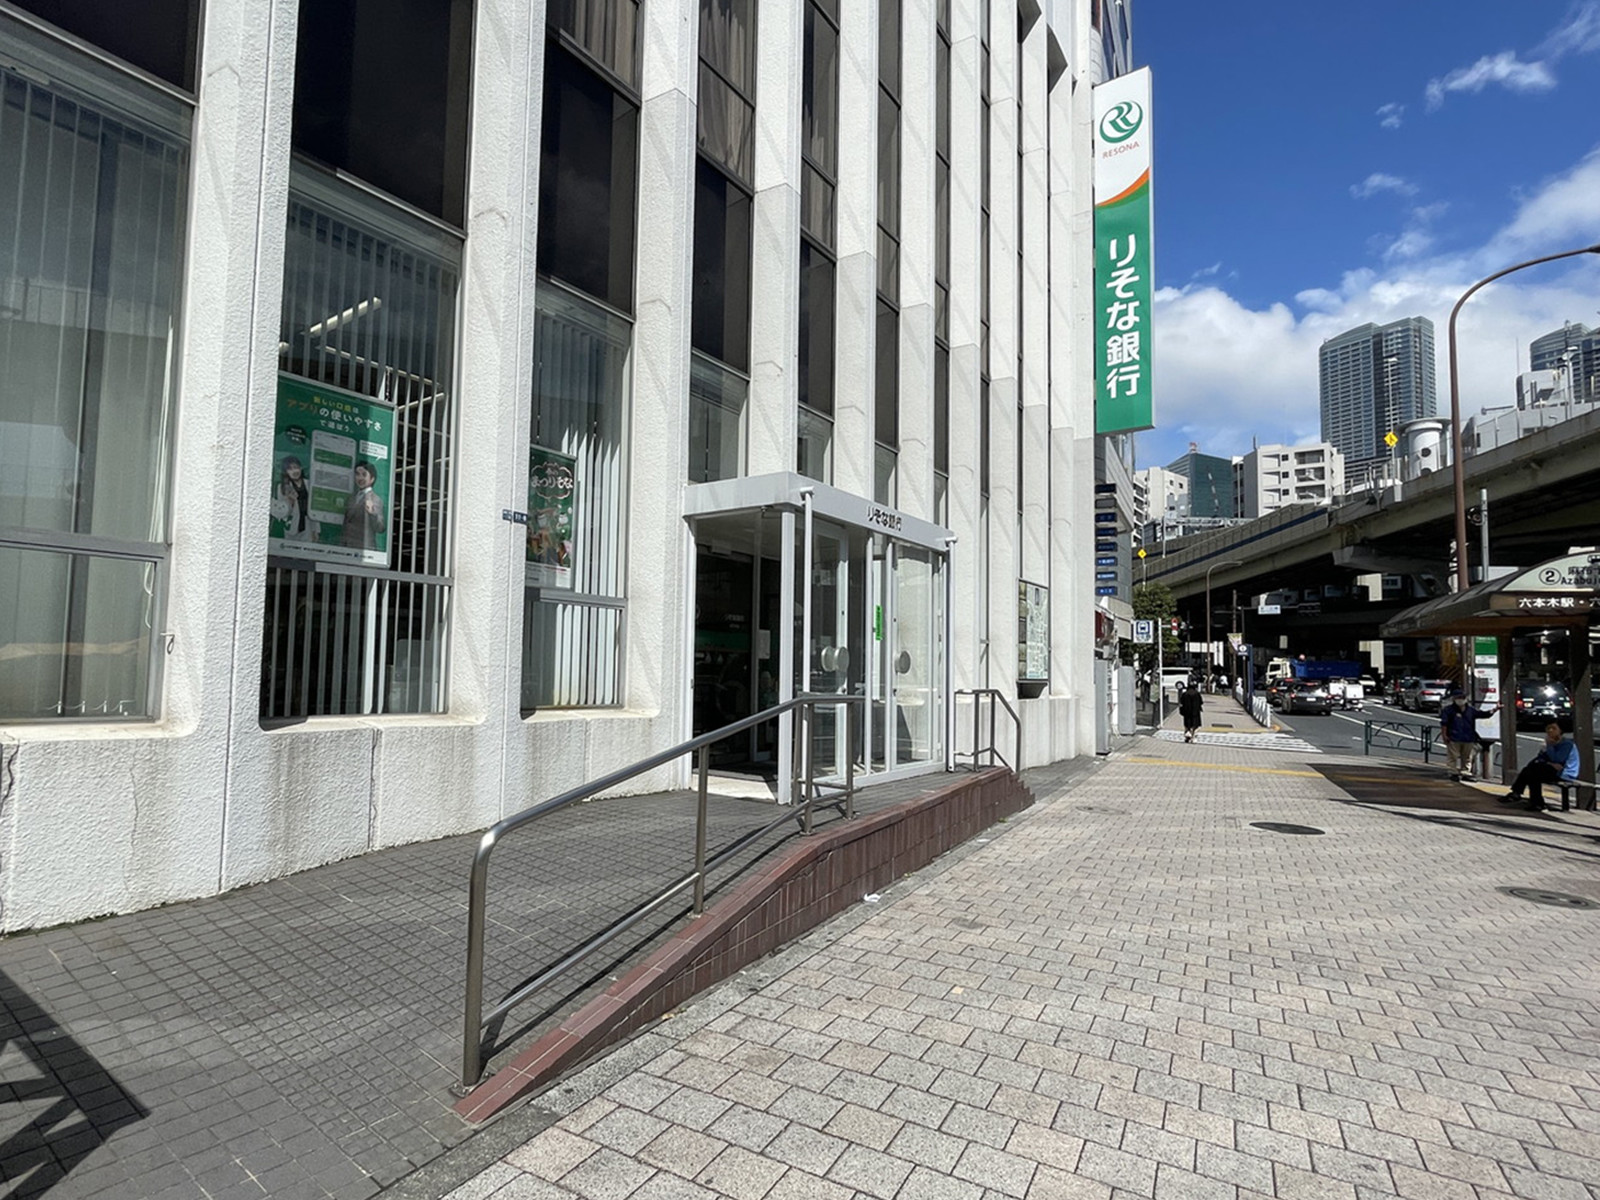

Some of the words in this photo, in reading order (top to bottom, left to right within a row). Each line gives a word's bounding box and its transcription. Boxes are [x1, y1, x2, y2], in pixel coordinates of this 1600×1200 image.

[1102, 140, 1140, 160] RESONA
[1105, 232, 1142, 399] りそな銀行
